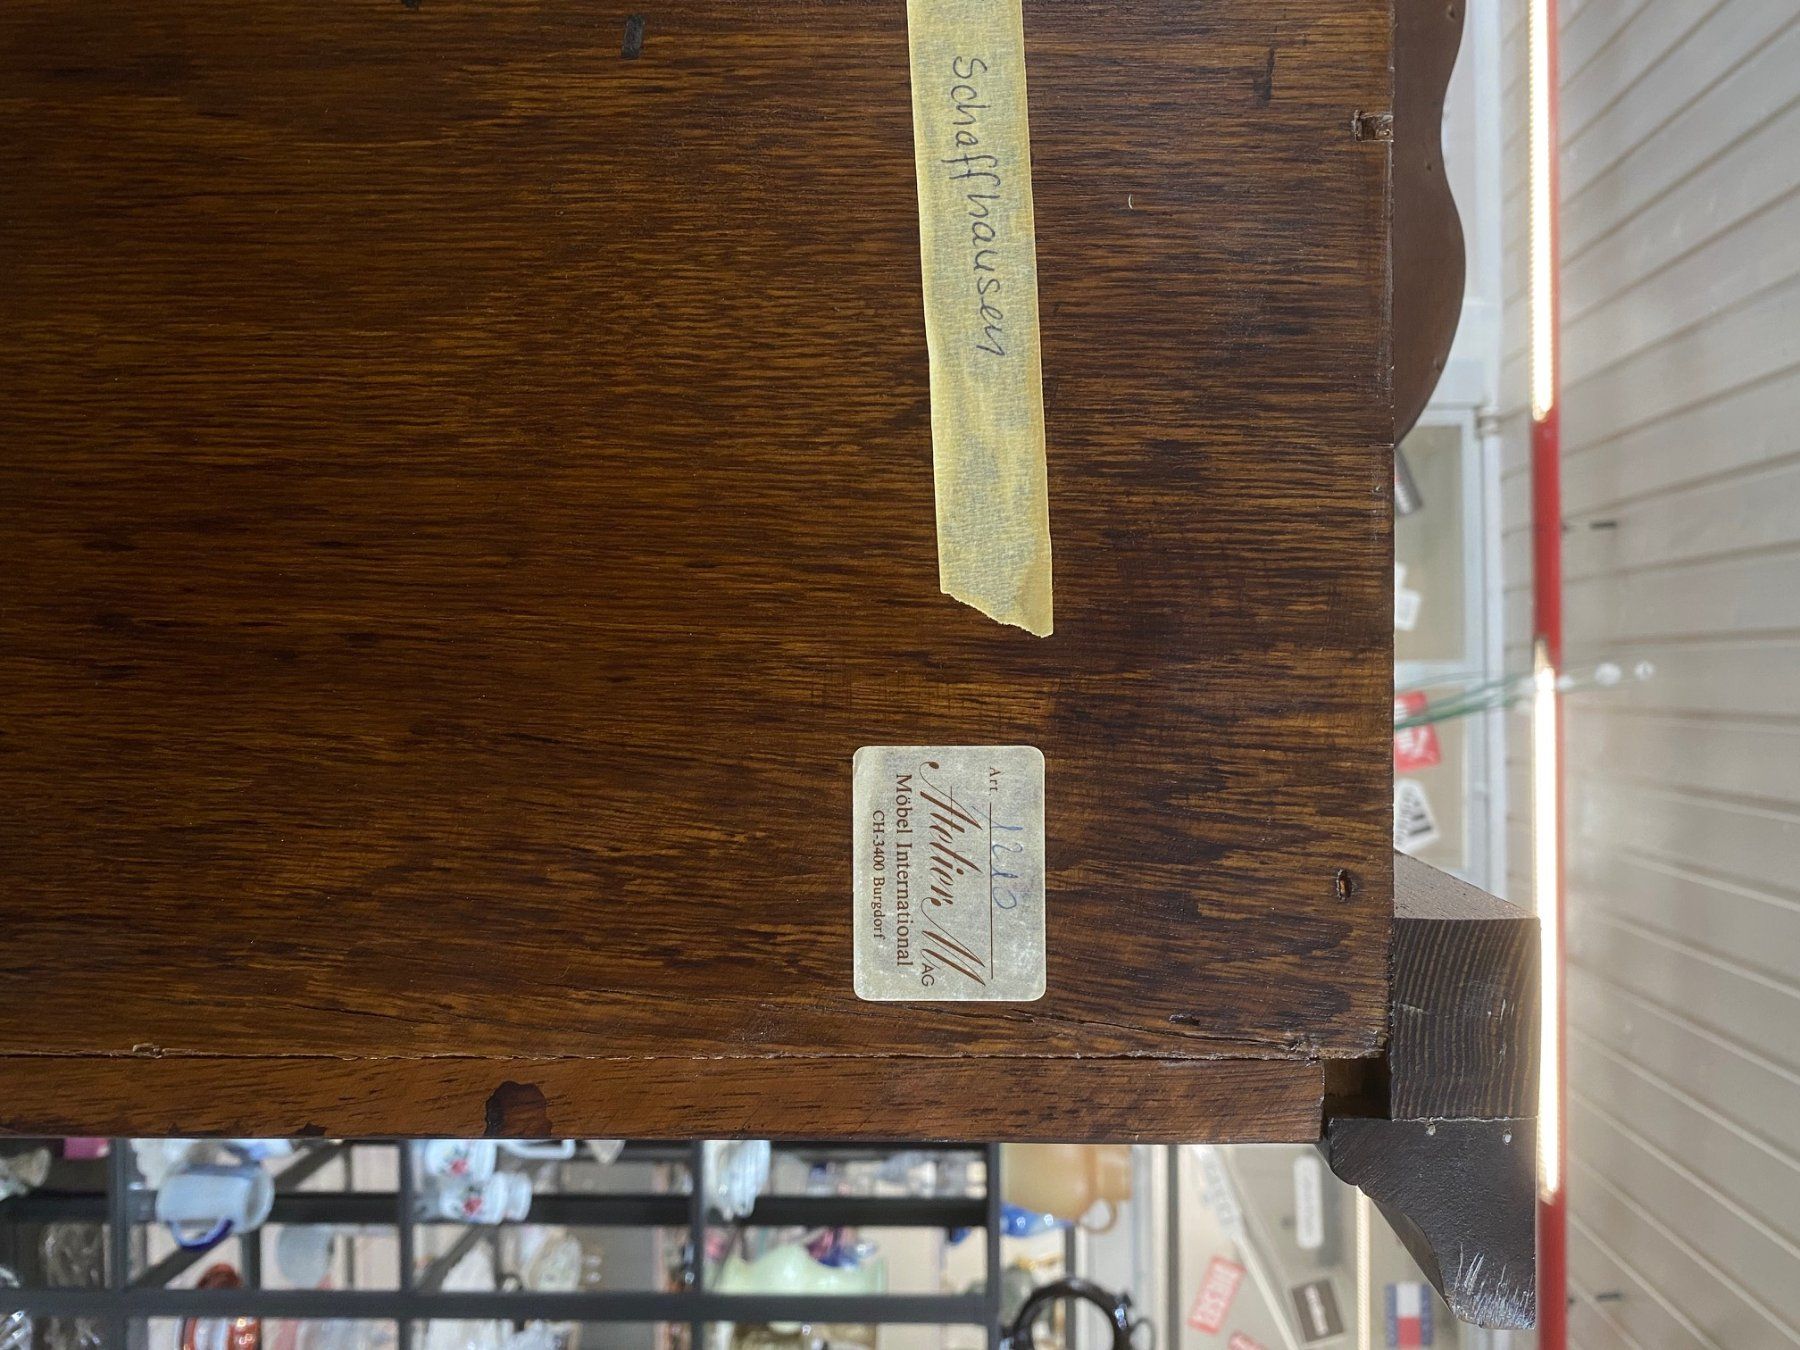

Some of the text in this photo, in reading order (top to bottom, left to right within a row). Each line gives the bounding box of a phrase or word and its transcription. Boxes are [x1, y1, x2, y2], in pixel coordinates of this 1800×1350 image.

[941, 56, 1005, 356] Schaffhausen
[871, 810, 886, 941] CH-3400 Burgdorf
[896, 774, 914, 967] Möbel International
[919, 761, 986, 987] Atelier M AG
[989, 766, 1001, 797] Art.
